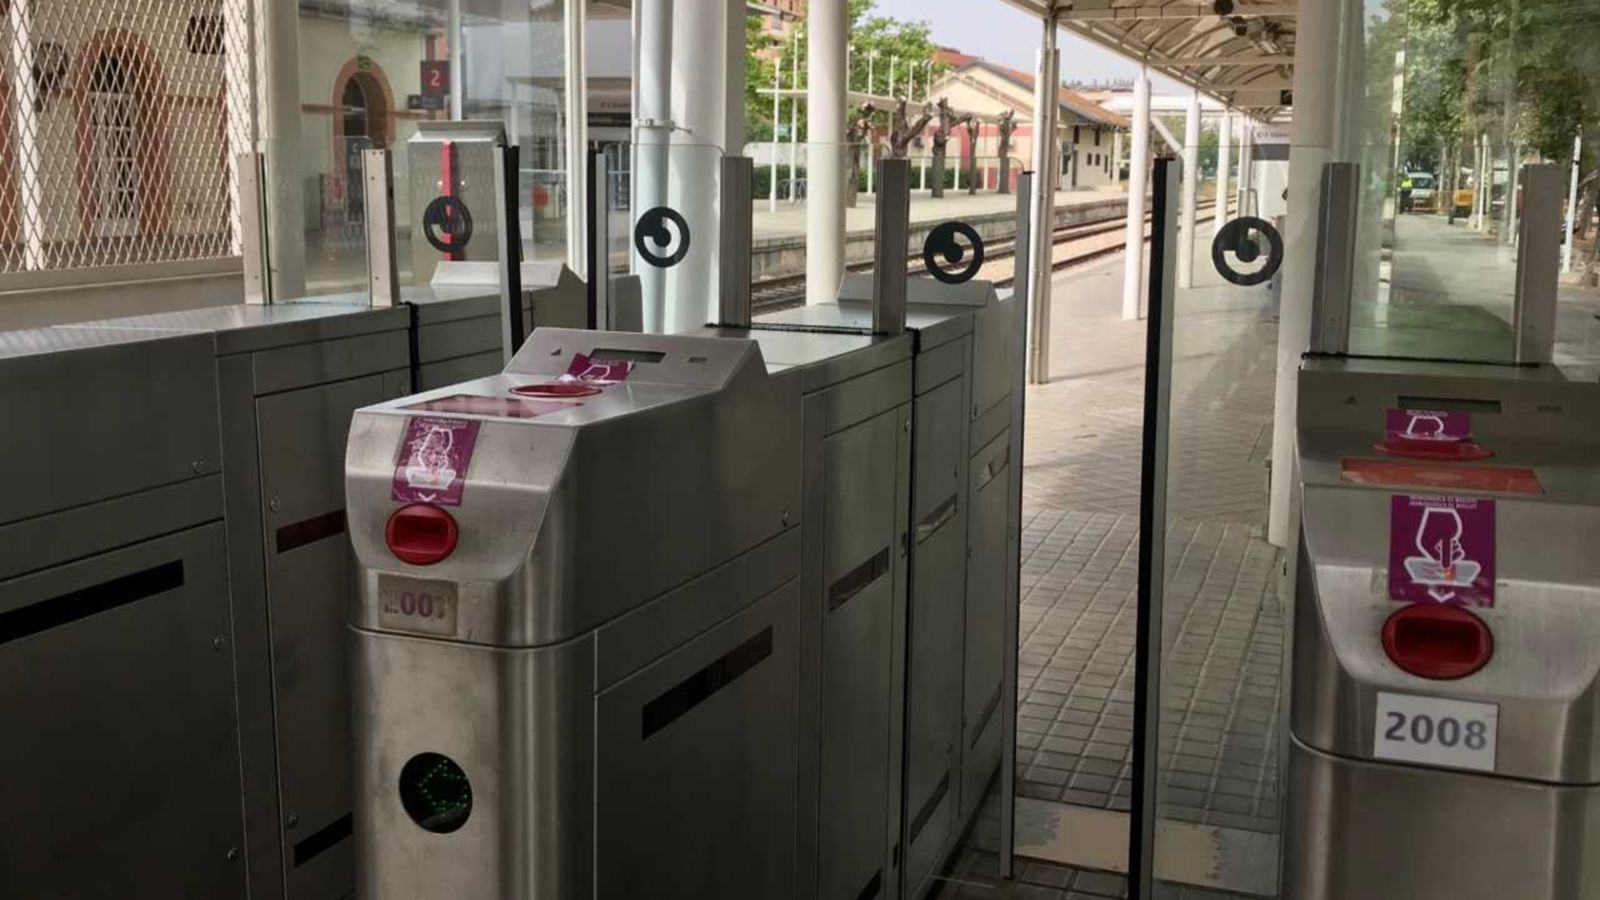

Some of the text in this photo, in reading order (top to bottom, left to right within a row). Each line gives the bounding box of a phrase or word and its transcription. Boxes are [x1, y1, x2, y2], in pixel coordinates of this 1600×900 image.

[430, 70, 440, 87] 2
[384, 590, 449, 619] 00
[1385, 711, 1486, 750] 2008
